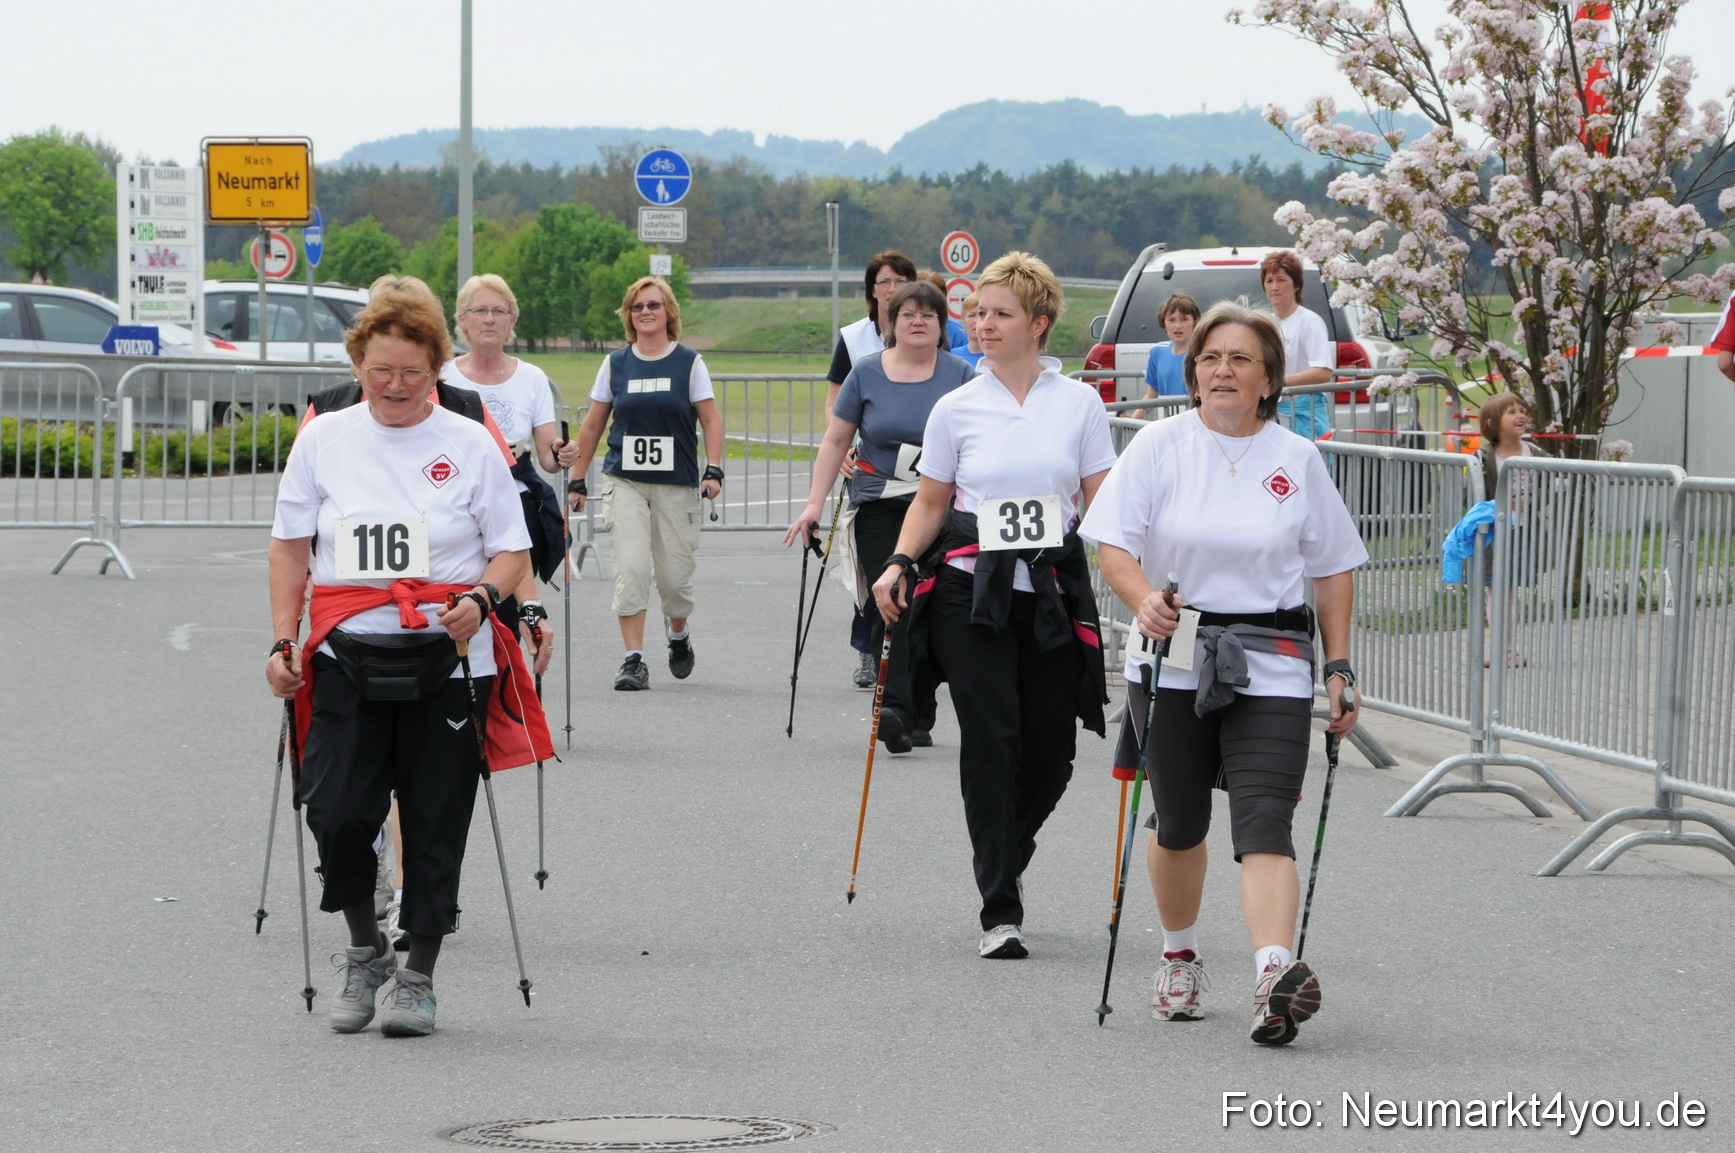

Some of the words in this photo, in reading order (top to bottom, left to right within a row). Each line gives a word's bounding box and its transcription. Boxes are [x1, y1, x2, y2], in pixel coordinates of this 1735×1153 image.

[244, 155, 273, 165] Nach
[217, 171, 300, 190] Neumarkt
[246, 196, 252, 207] 5
[260, 197, 275, 208] km
[643, 220, 681, 229] schaftlicher
[646, 211, 679, 220] Landwirt-
[643, 229, 668, 238] Verkehr
[670, 229, 682, 238] frei
[950, 244, 970, 263] 60
[137, 275, 165, 294] THULE
[113, 338, 155, 355] VOLVO
[633, 437, 663, 466] 95
[998, 499, 1045, 543] 33
[353, 522, 410, 572] 116
